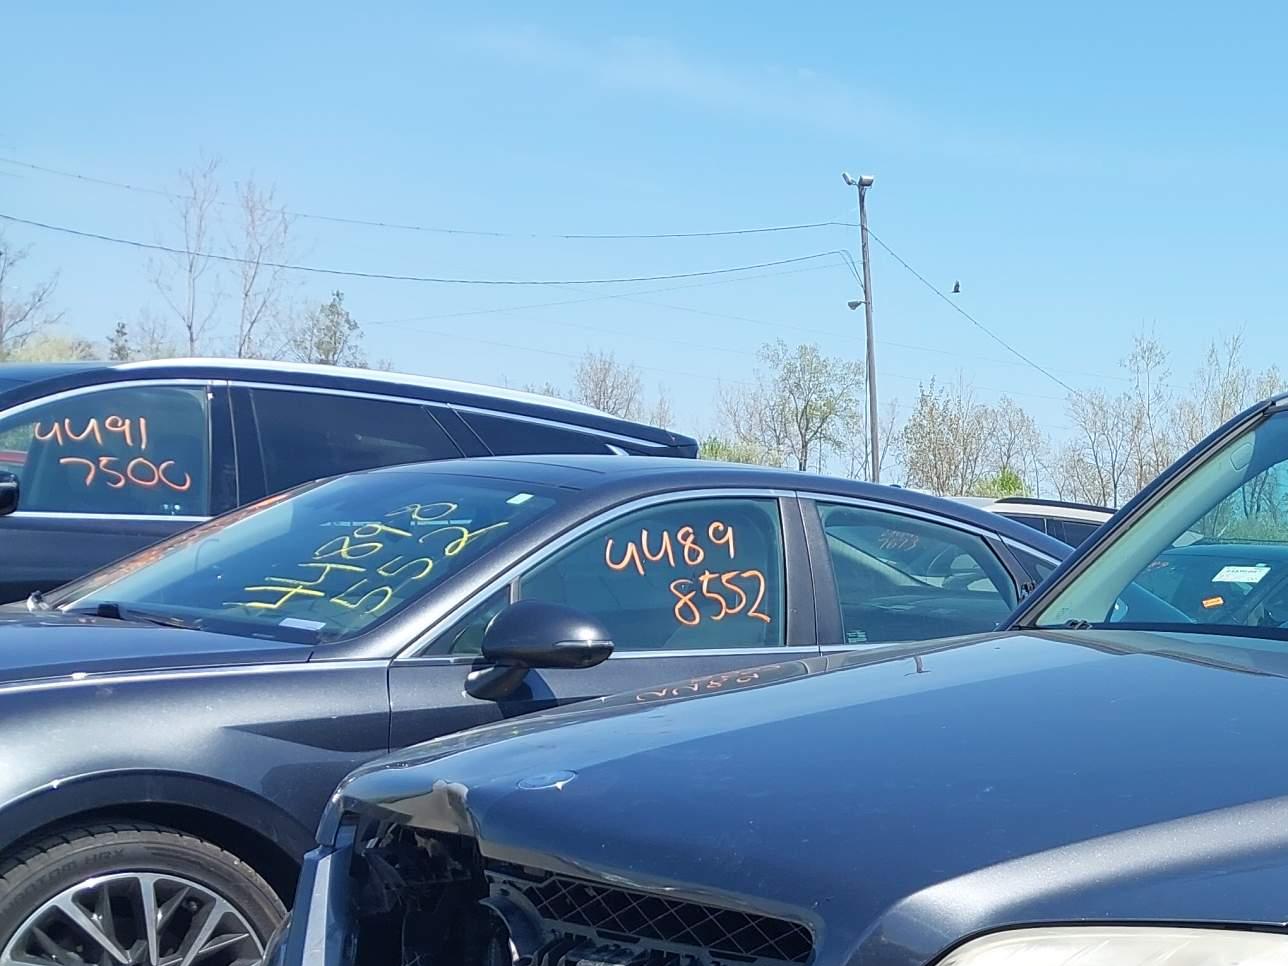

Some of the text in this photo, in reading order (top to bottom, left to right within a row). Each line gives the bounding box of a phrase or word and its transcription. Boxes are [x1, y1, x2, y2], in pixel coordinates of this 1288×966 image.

[35, 415, 146, 450] 4491
[605, 521, 736, 576] 4489
[669, 569, 772, 626] 8552
